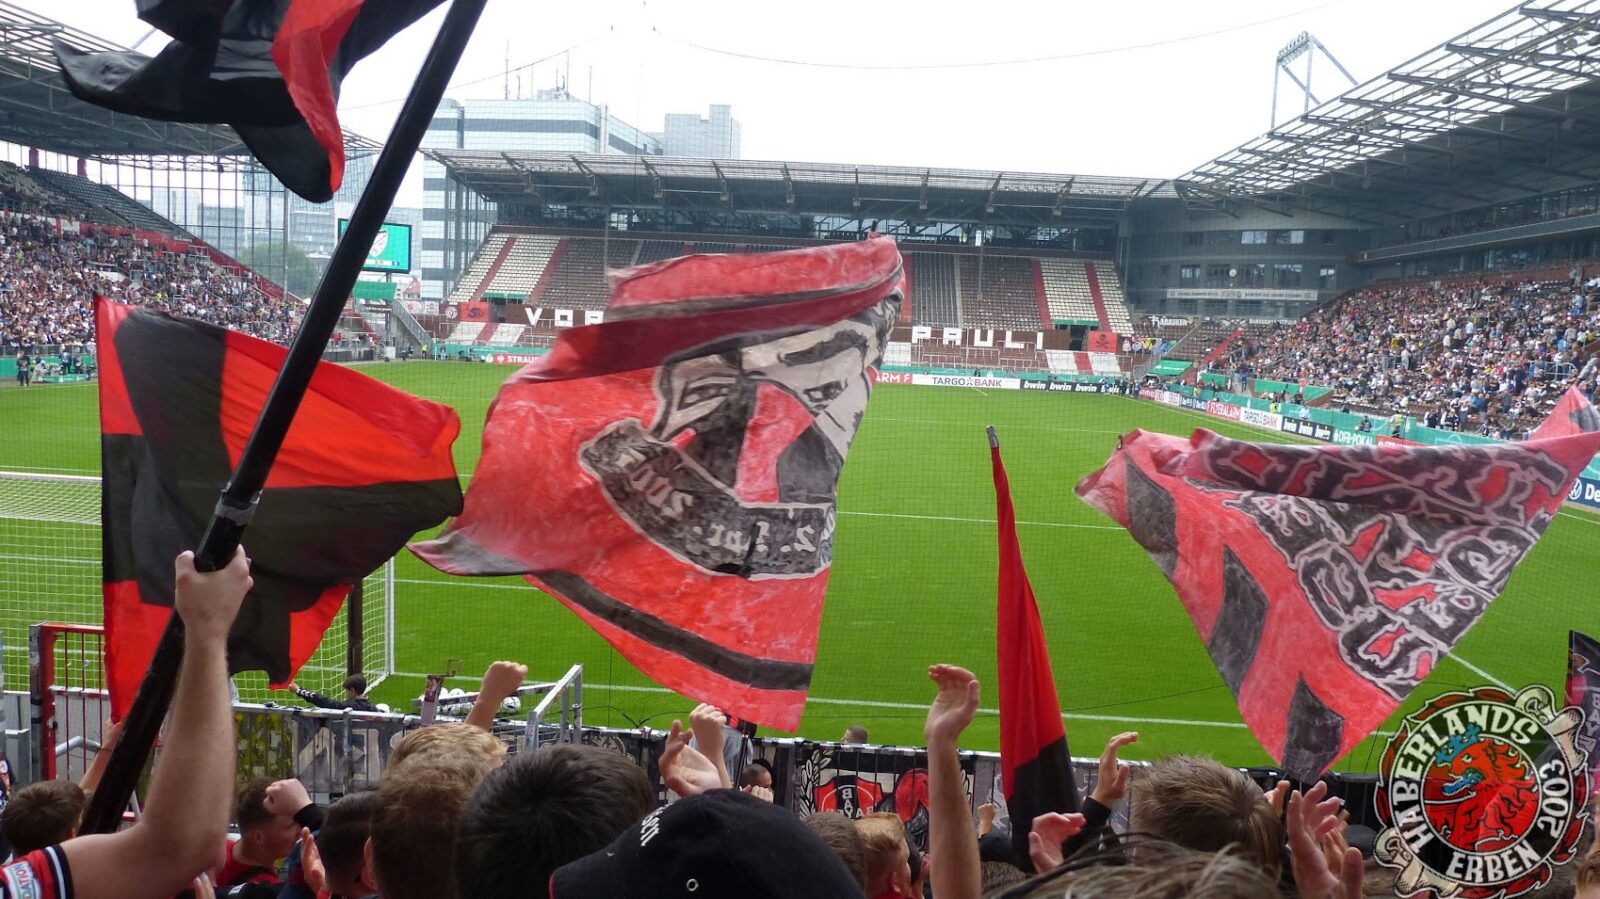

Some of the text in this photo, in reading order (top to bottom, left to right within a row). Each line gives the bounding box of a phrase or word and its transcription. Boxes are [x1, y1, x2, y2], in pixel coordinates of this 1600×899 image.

[912, 326, 1044, 350] PAULI
[876, 372, 900, 384] ARM
[1023, 380, 1046, 390] bwin
[1049, 382, 1072, 392] bwin
[1075, 383, 1097, 393] bwin
